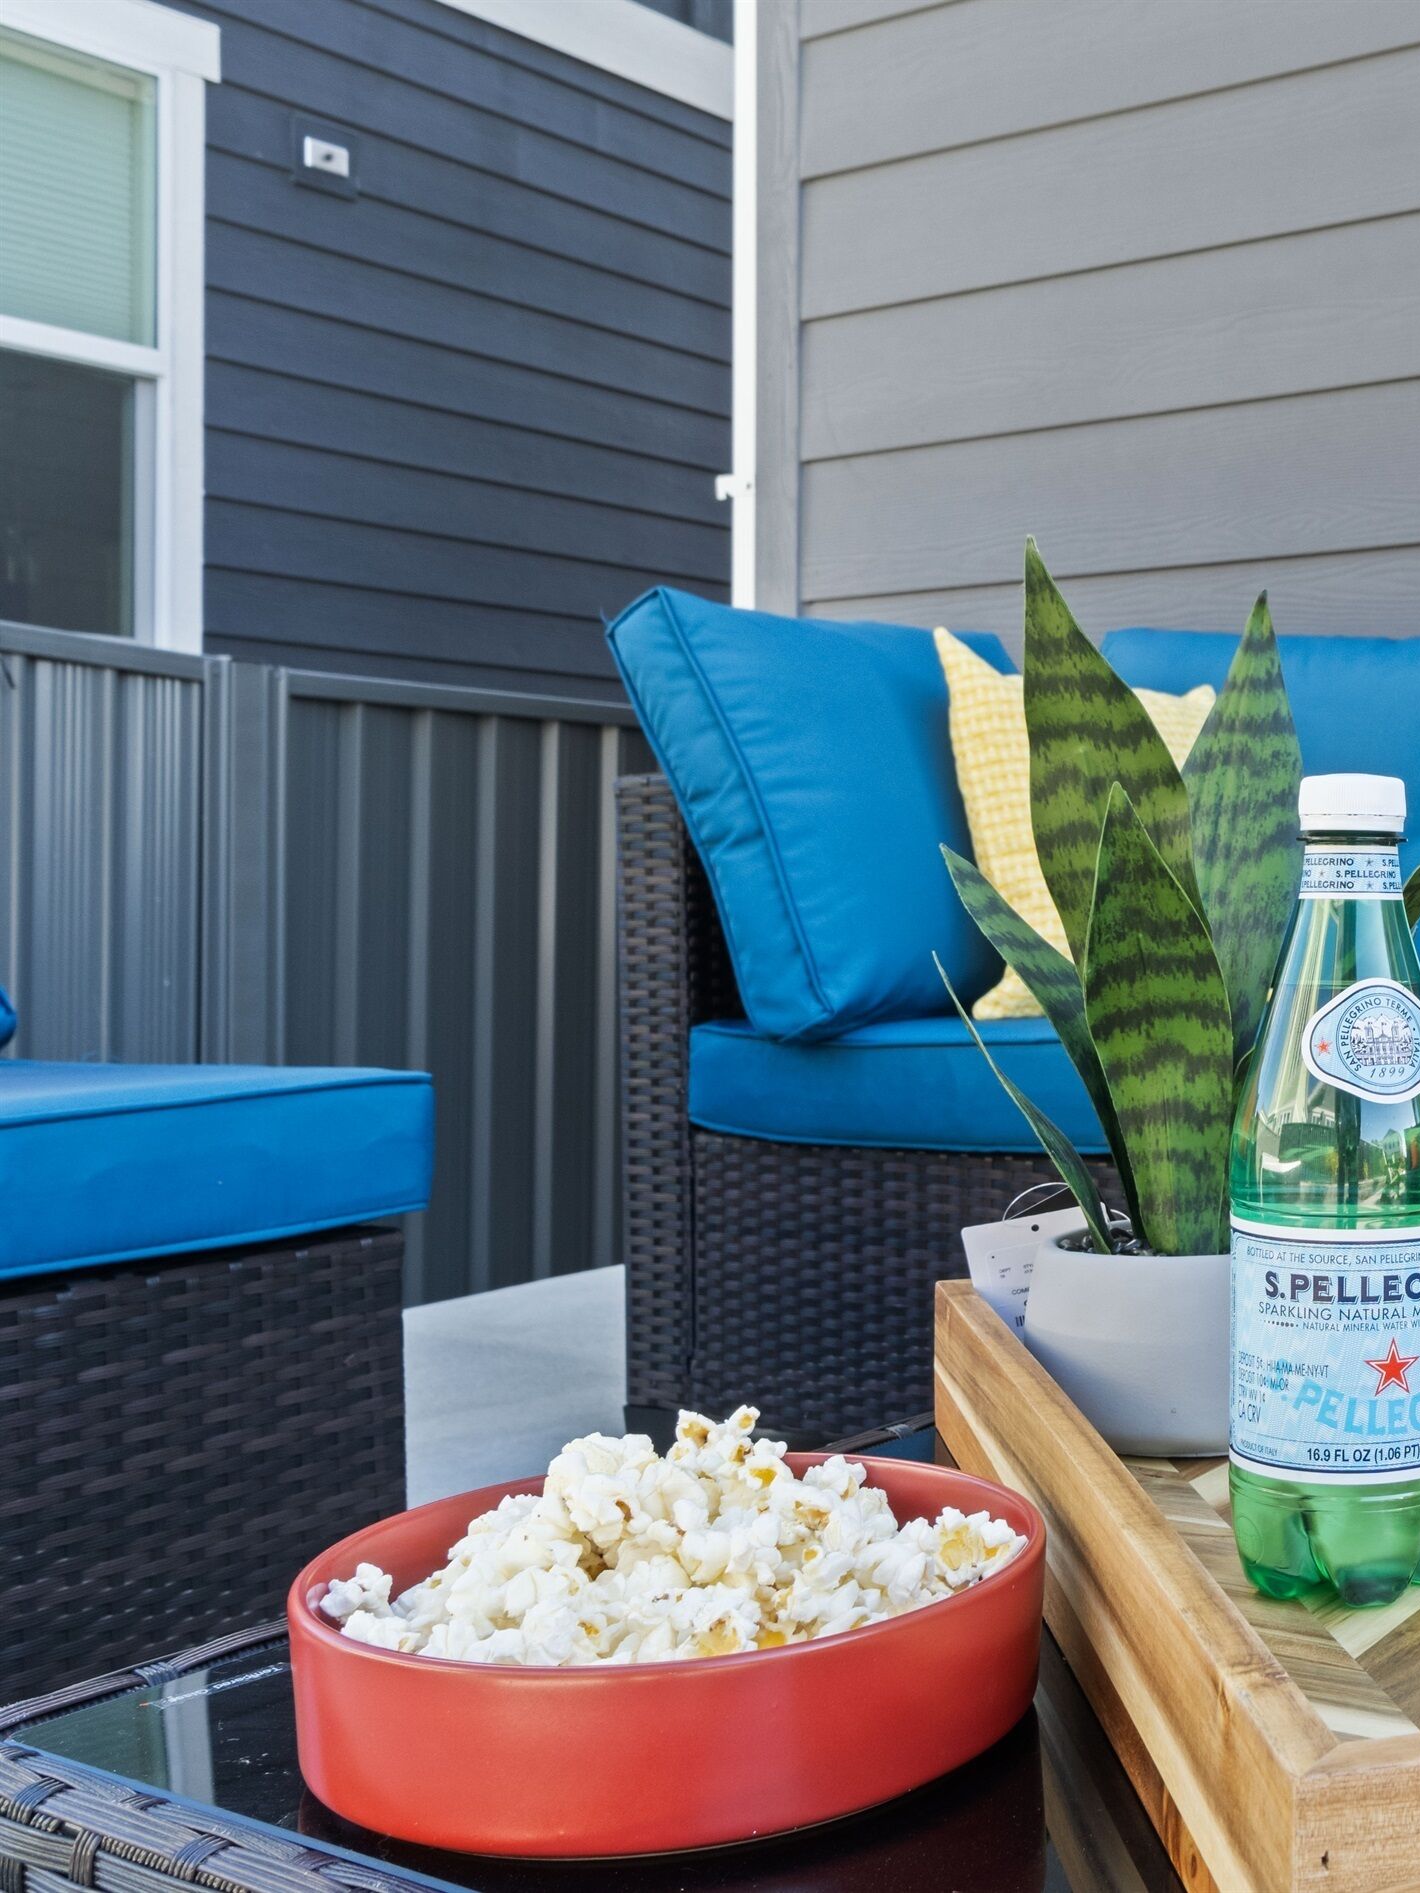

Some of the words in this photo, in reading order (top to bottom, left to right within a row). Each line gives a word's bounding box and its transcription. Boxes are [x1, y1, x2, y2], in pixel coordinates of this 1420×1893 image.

[1385, 998, 1413, 1022] TERME
[1340, 997, 1382, 1047] PELLEGRINO
[1344, 1051, 1362, 1072] SAN
[1409, 1037, 1420, 1068] ITALIA
[1370, 1066, 1405, 1079] 1899
[1247, 1246, 1274, 1260] BOTTLED
[1277, 1252, 1287, 1261] AT
[1290, 1253, 1305, 1264] THE
[1309, 1254, 1351, 1266] SOURCE,
[1356, 1255, 1376, 1265] SAN
[1259, 1301, 1332, 1321] SPARKLING
[1339, 1307, 1406, 1321] NATURAL
[1302, 1322, 1340, 1332] NATURAL
[1342, 1322, 1380, 1332] MINERAL
[1383, 1321, 1408, 1331] WATER
[1247, 1403, 1261, 1423] CRV
[1307, 1448, 1331, 1462] 16.9
[1334, 1449, 1349, 1462] FL
[1353, 1449, 1370, 1462] OZ
[1375, 1447, 1401, 1464] (1.06
[1404, 1443, 1420, 1459] PT)
